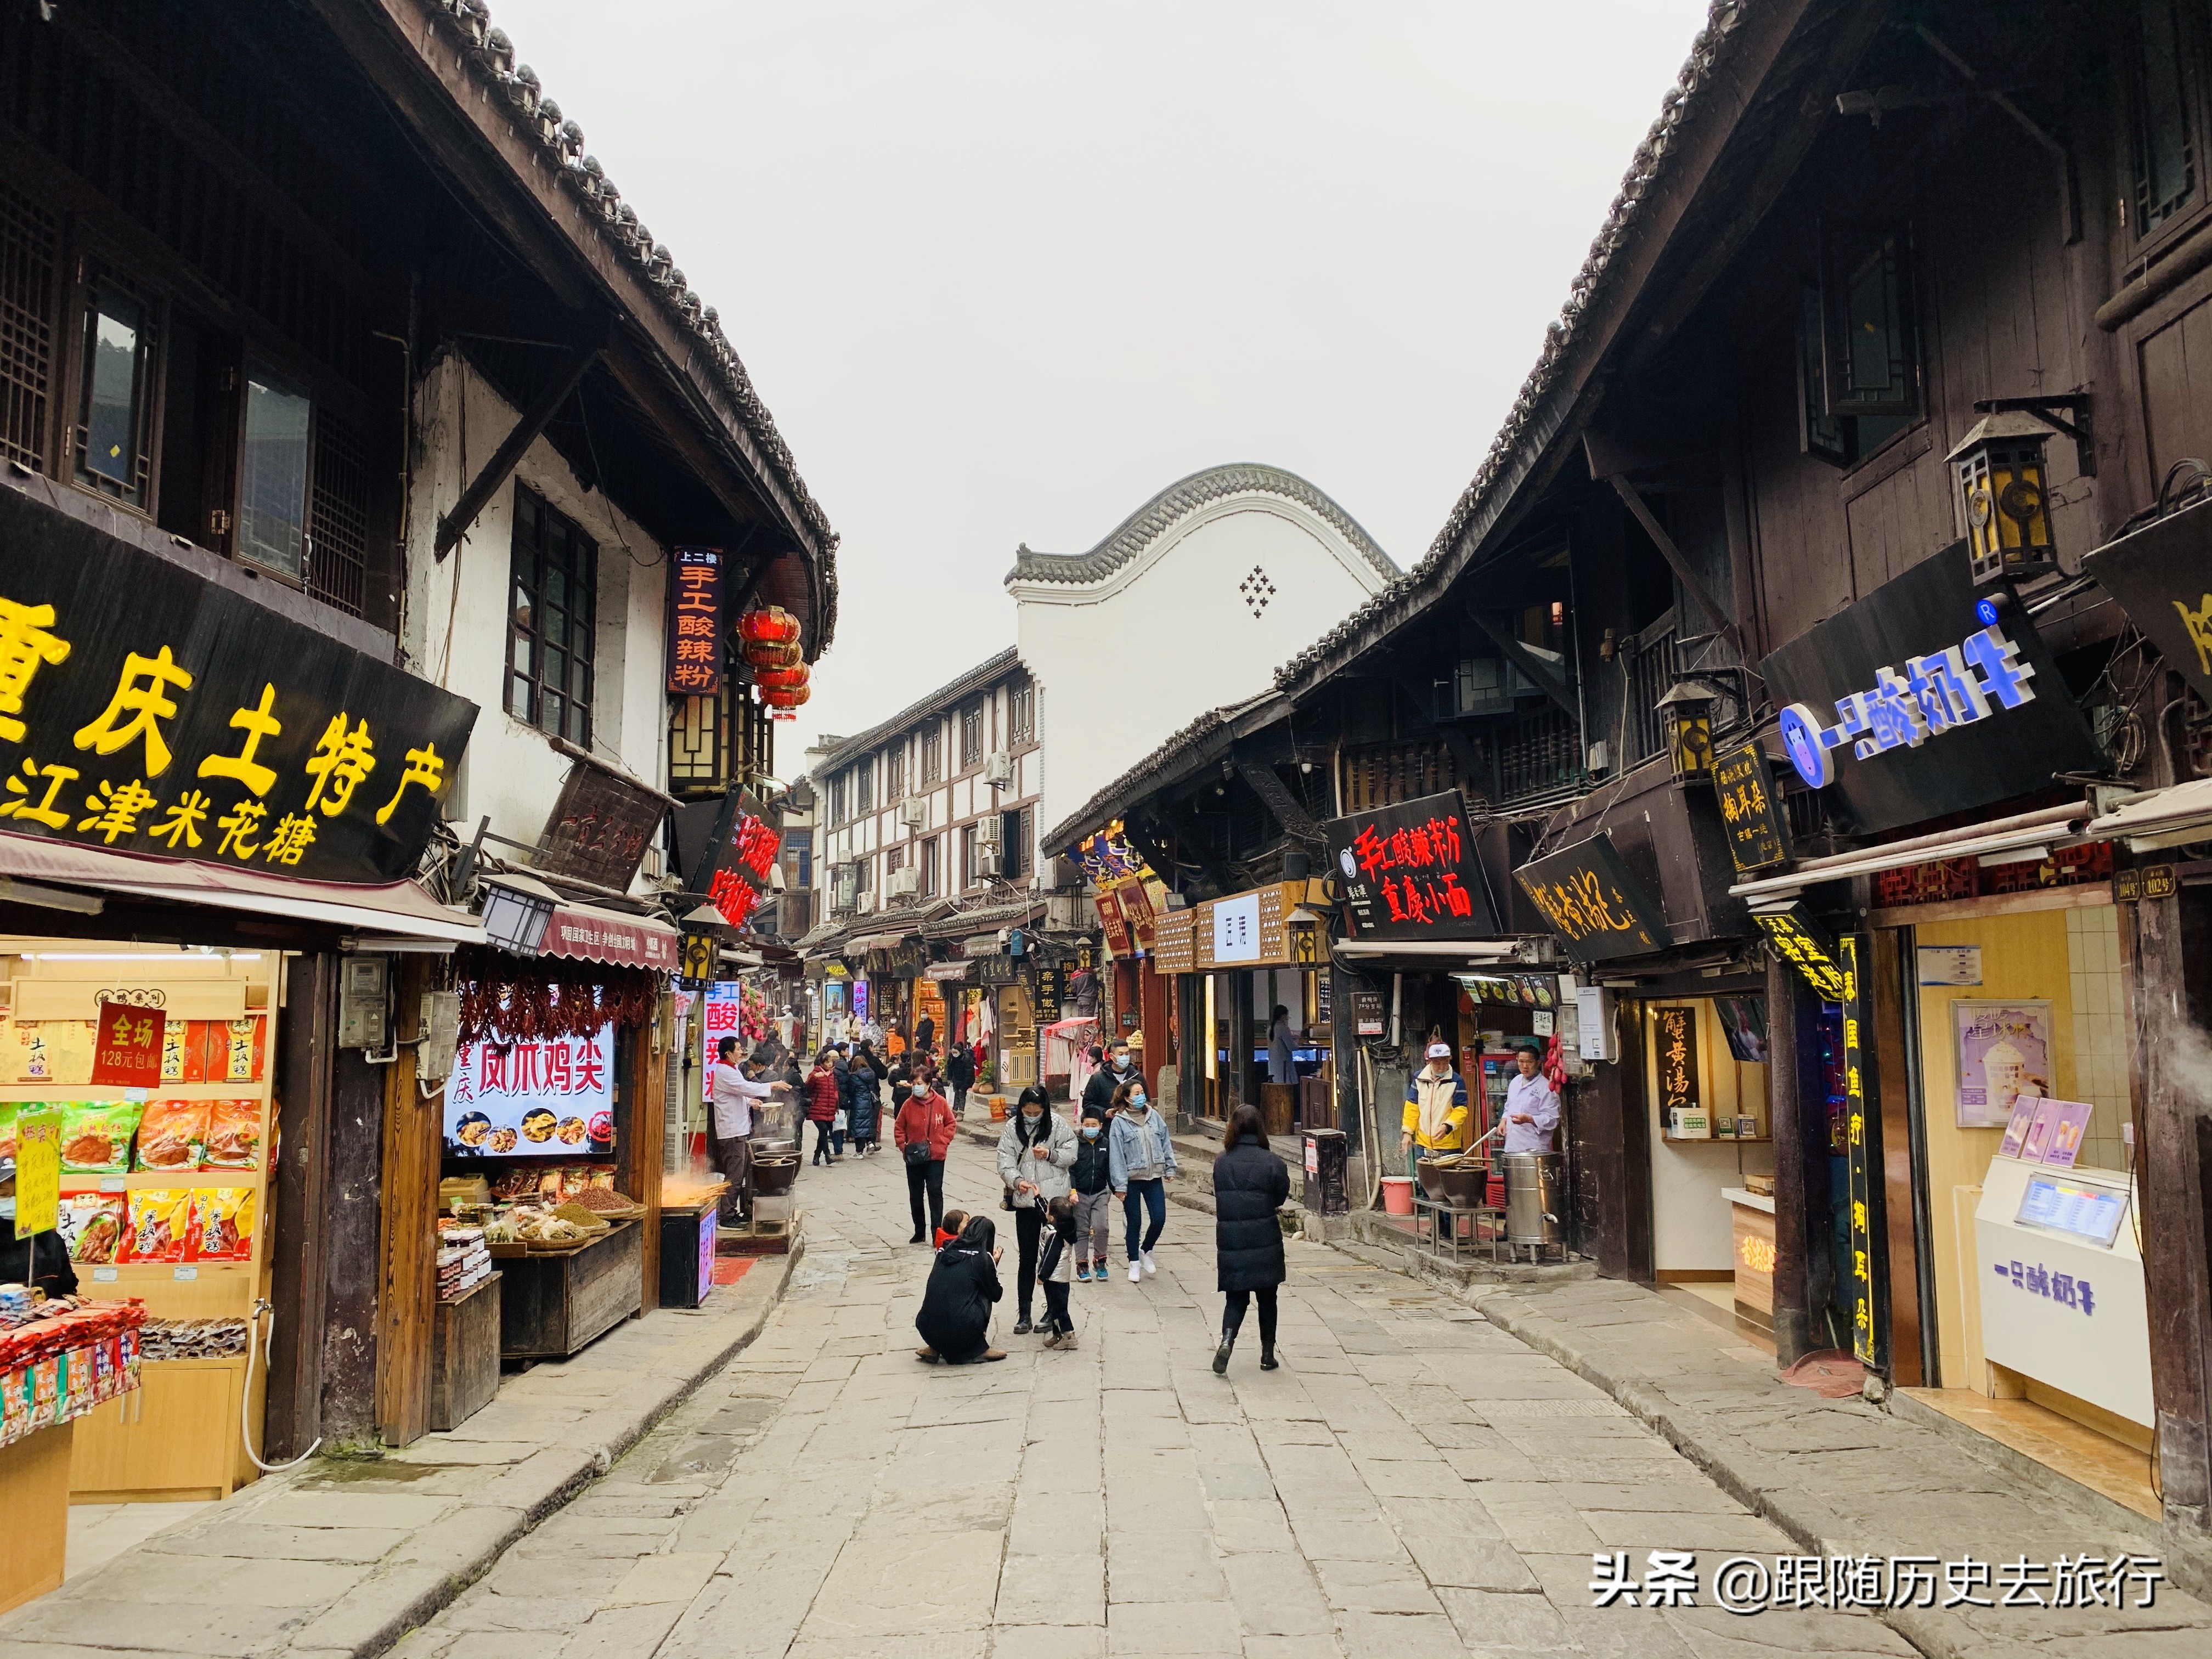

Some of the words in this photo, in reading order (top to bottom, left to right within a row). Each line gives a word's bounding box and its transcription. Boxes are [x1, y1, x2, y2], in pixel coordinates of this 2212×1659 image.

[680, 551, 717, 565] 上二楼
[674, 566, 719, 688] 手工酸辣粉
[0, 595, 445, 827] 重庆土特产
[1818, 624, 2036, 761] 一只酸奶牛
[0, 757, 318, 866] 江津米花糖
[1723, 779, 1766, 823] 掏耳朵
[2119, 882, 2136, 897] 104号
[2147, 878, 2169, 894] 102号
[1774, 934, 1830, 962] 密室
[112, 1014, 154, 1049] 全场
[101, 1049, 159, 1069] 128元包邮
[479, 1040, 604, 1097] 凤爪鸡尖
[1994, 1260, 2096, 1317] 一只酸奶牛
